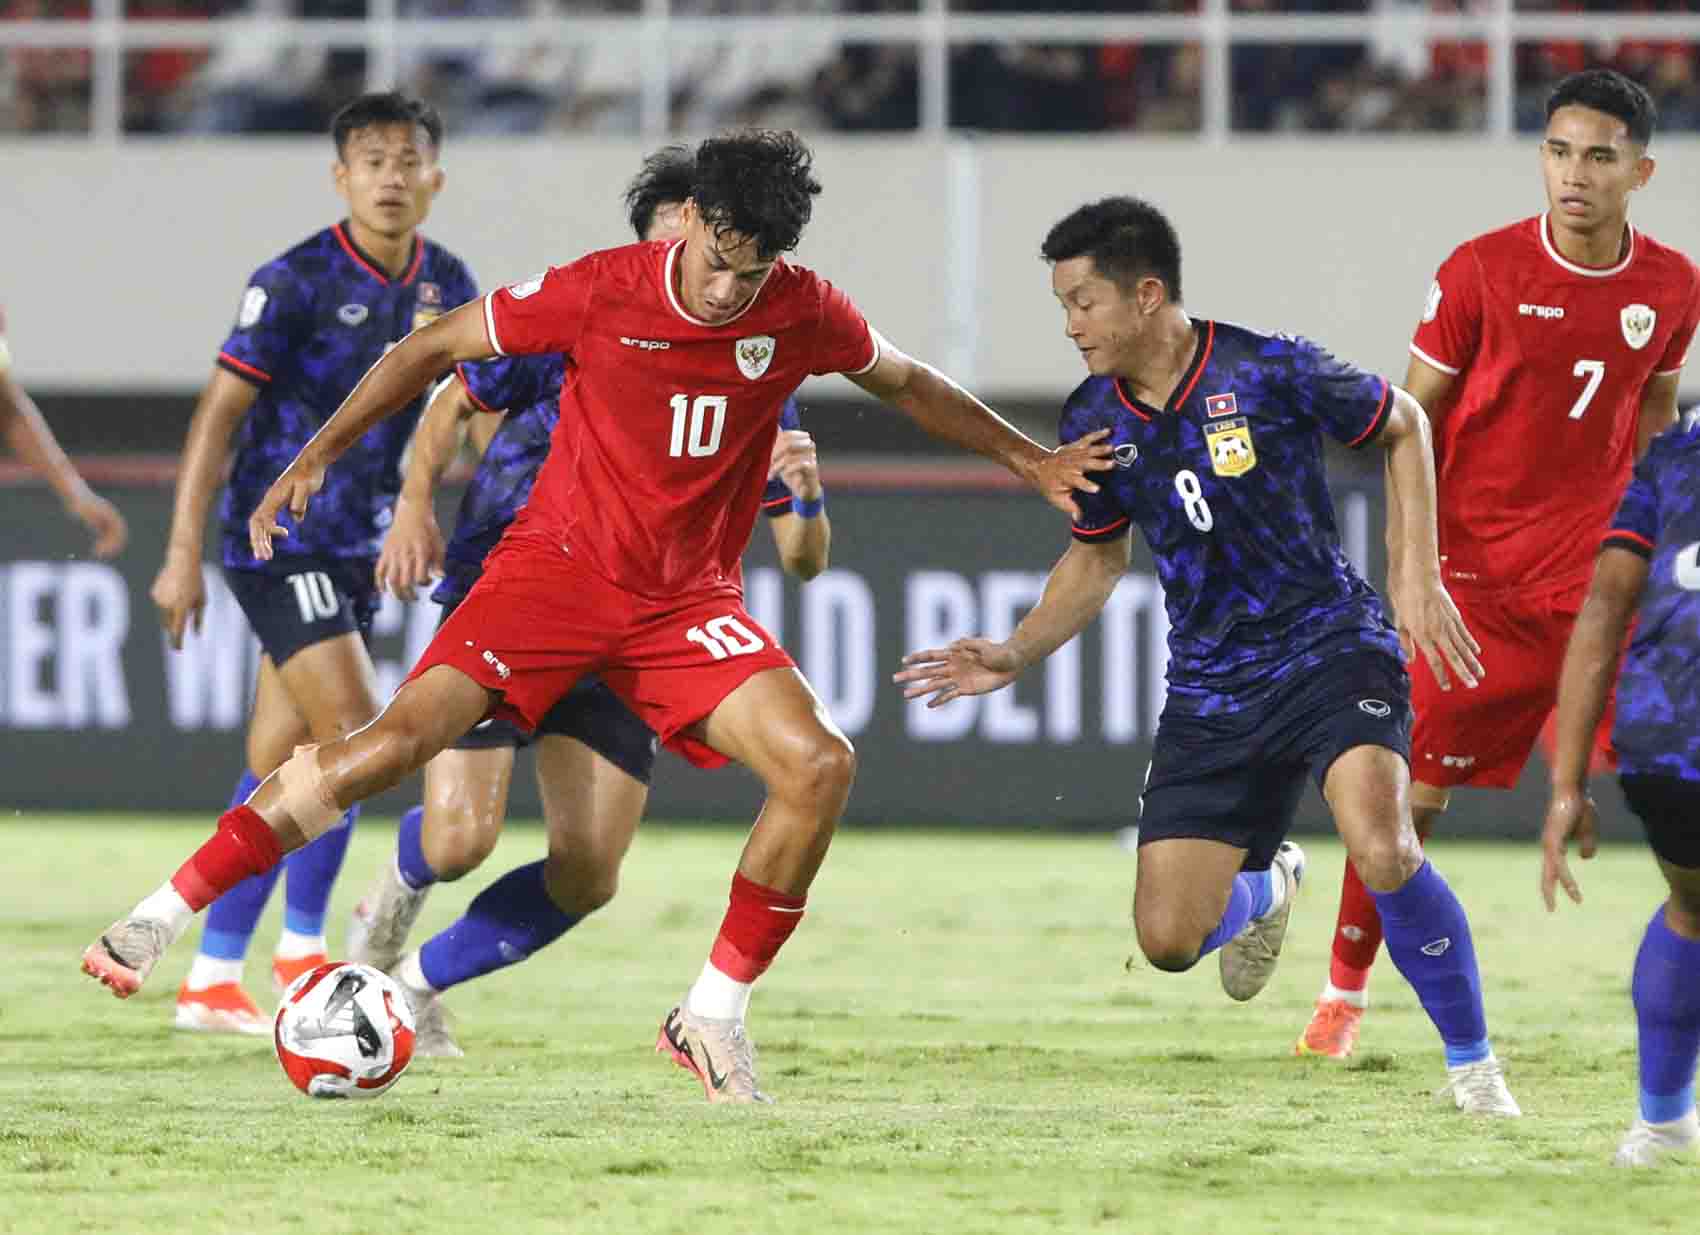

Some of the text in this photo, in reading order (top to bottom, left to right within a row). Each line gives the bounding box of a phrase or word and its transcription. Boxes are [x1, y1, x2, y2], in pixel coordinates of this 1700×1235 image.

[1568, 359, 1606, 420] 7
[669, 393, 728, 457] 10
[1175, 469, 1213, 532] 8
[286, 571, 340, 623] 10
[686, 615, 765, 660] 10
